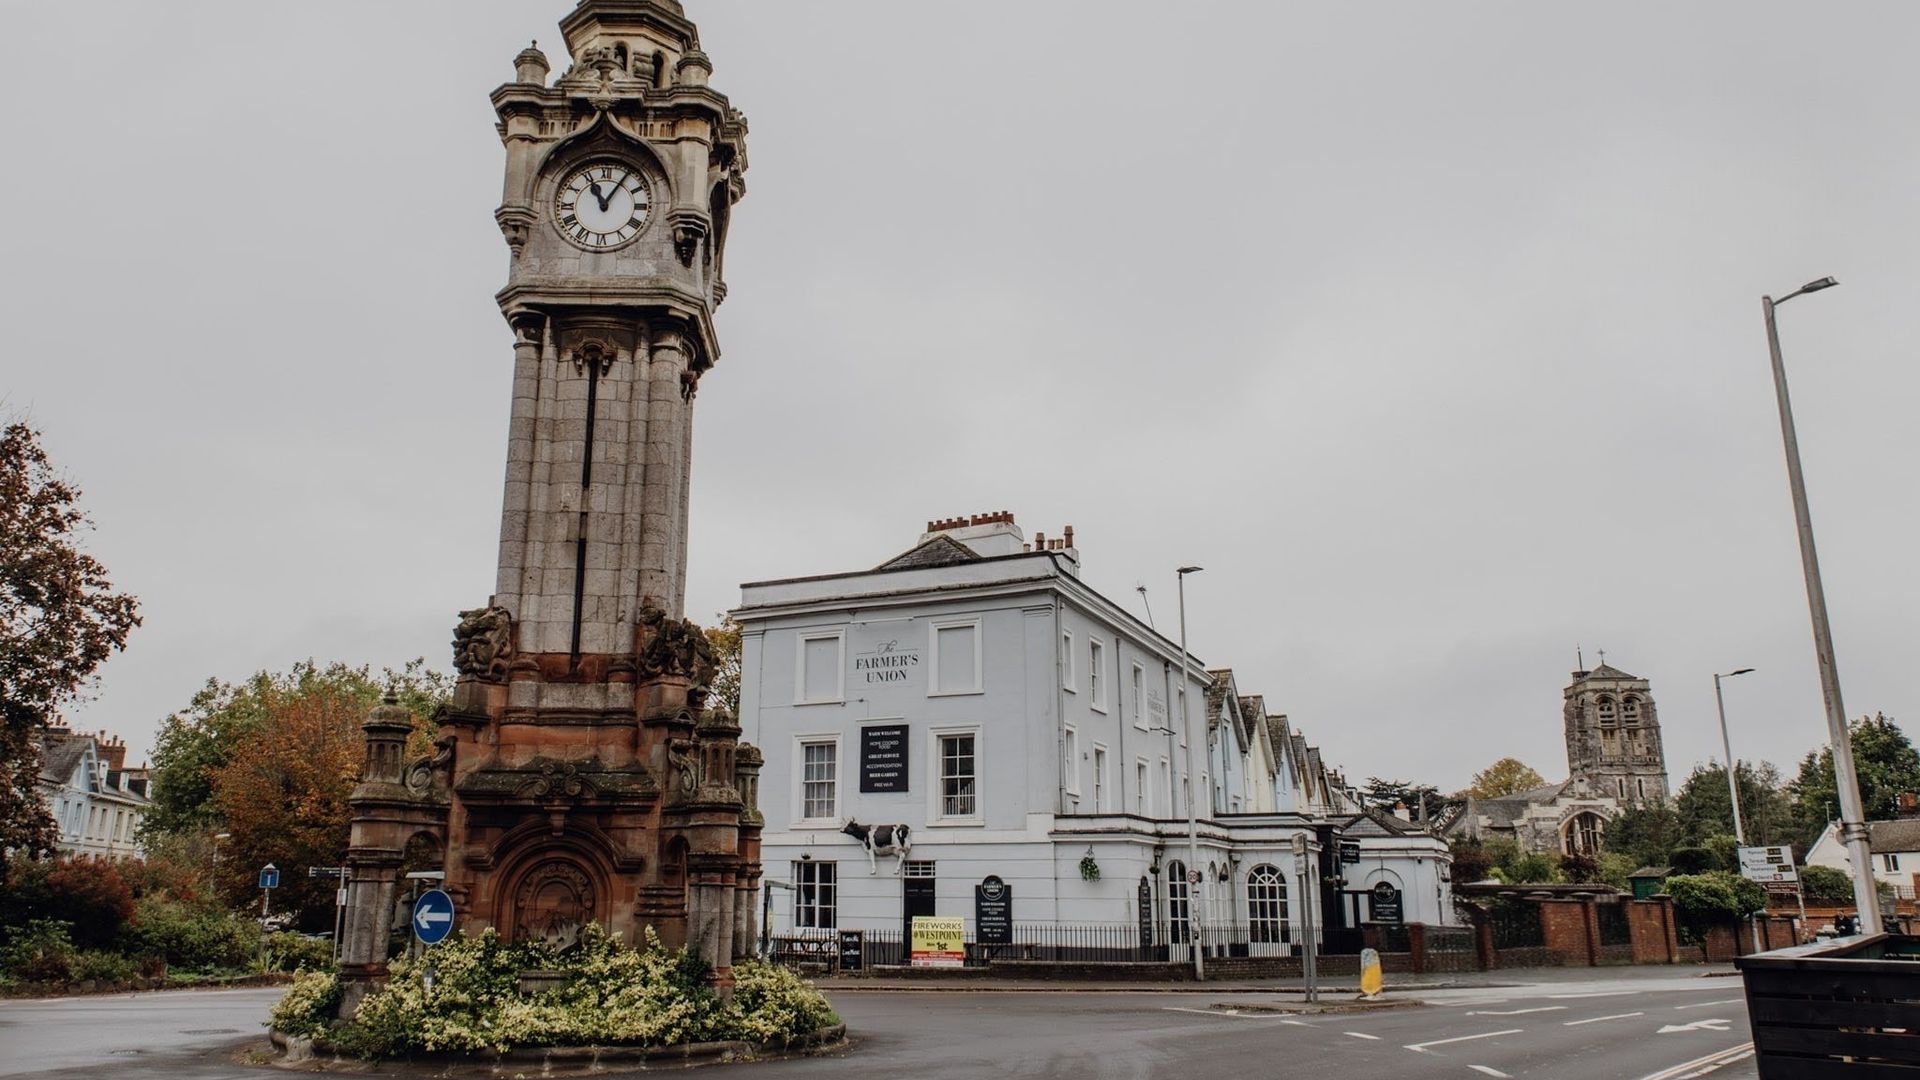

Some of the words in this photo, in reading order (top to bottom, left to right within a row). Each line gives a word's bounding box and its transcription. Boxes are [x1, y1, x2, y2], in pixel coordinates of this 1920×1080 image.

[856, 654, 918, 669] FARMER'S
[867, 670, 906, 682] UNION
[913, 922, 962, 930] FIREWORKS
